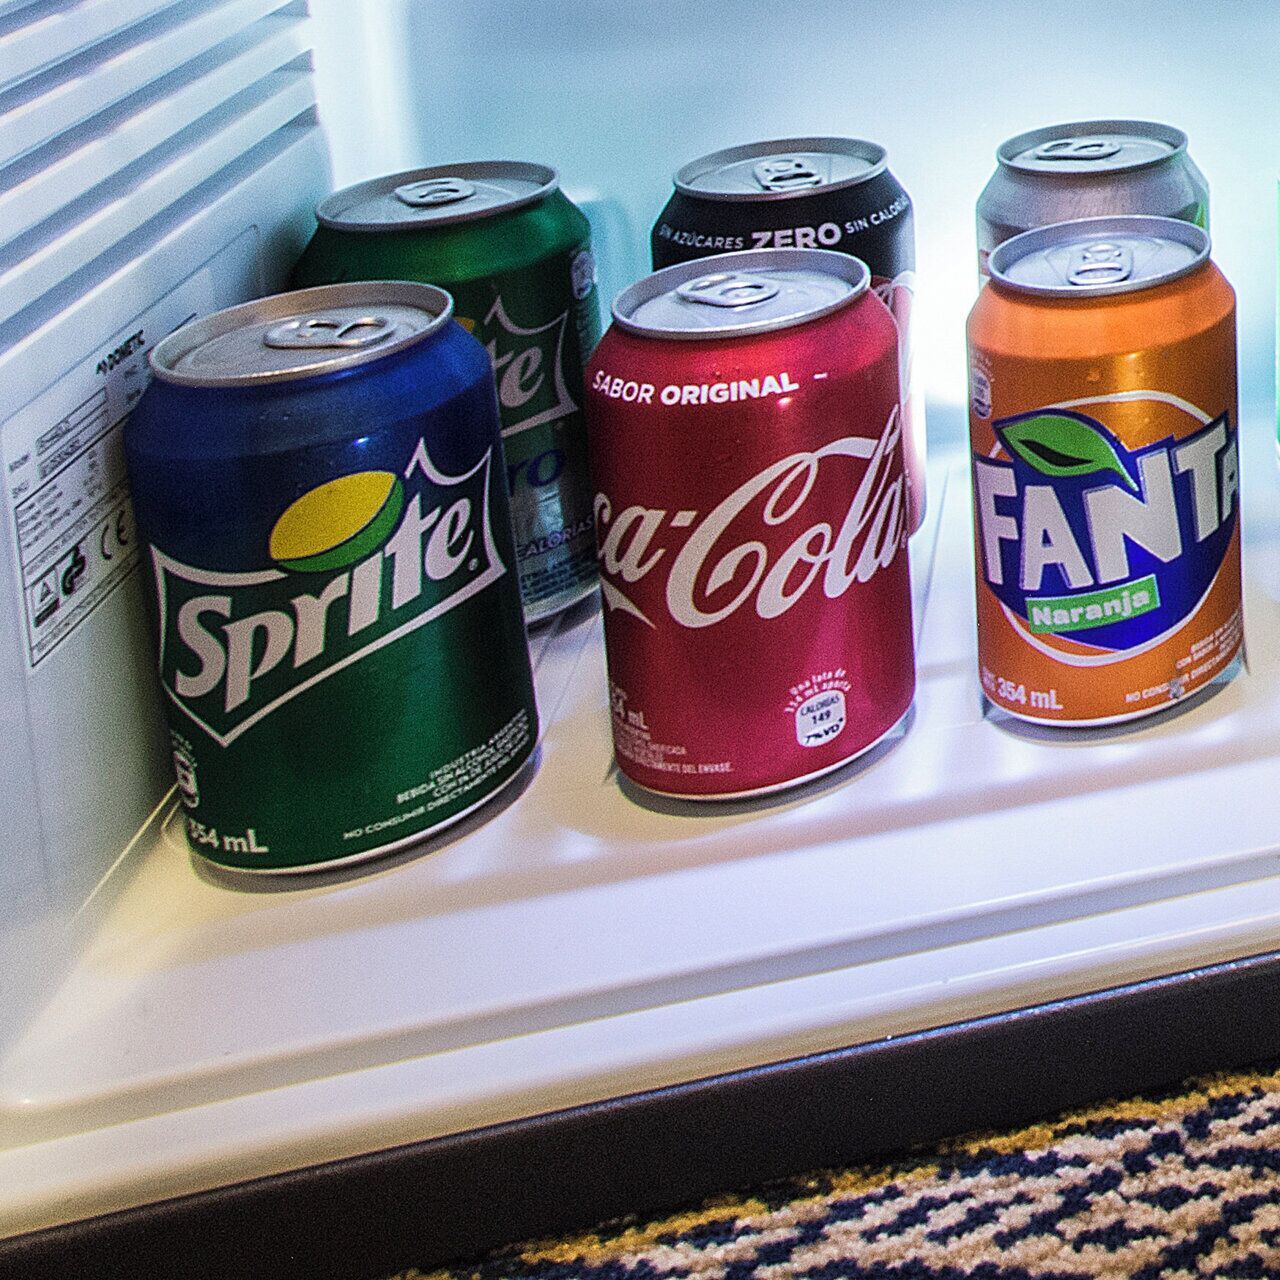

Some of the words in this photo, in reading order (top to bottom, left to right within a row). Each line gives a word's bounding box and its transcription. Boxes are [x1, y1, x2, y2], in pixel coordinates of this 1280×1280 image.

[751, 222, 842, 249] ZERO
[845, 218, 870, 234] SIN
[592, 370, 655, 405] SABOR
[660, 372, 800, 406] ORIGINAL
[175, 492, 478, 714] Sprite
[1032, 586, 1150, 630] Naranja
[997, 677, 1027, 705] 354
[1031, 688, 1064, 710] mL
[223, 828, 270, 853] mL
